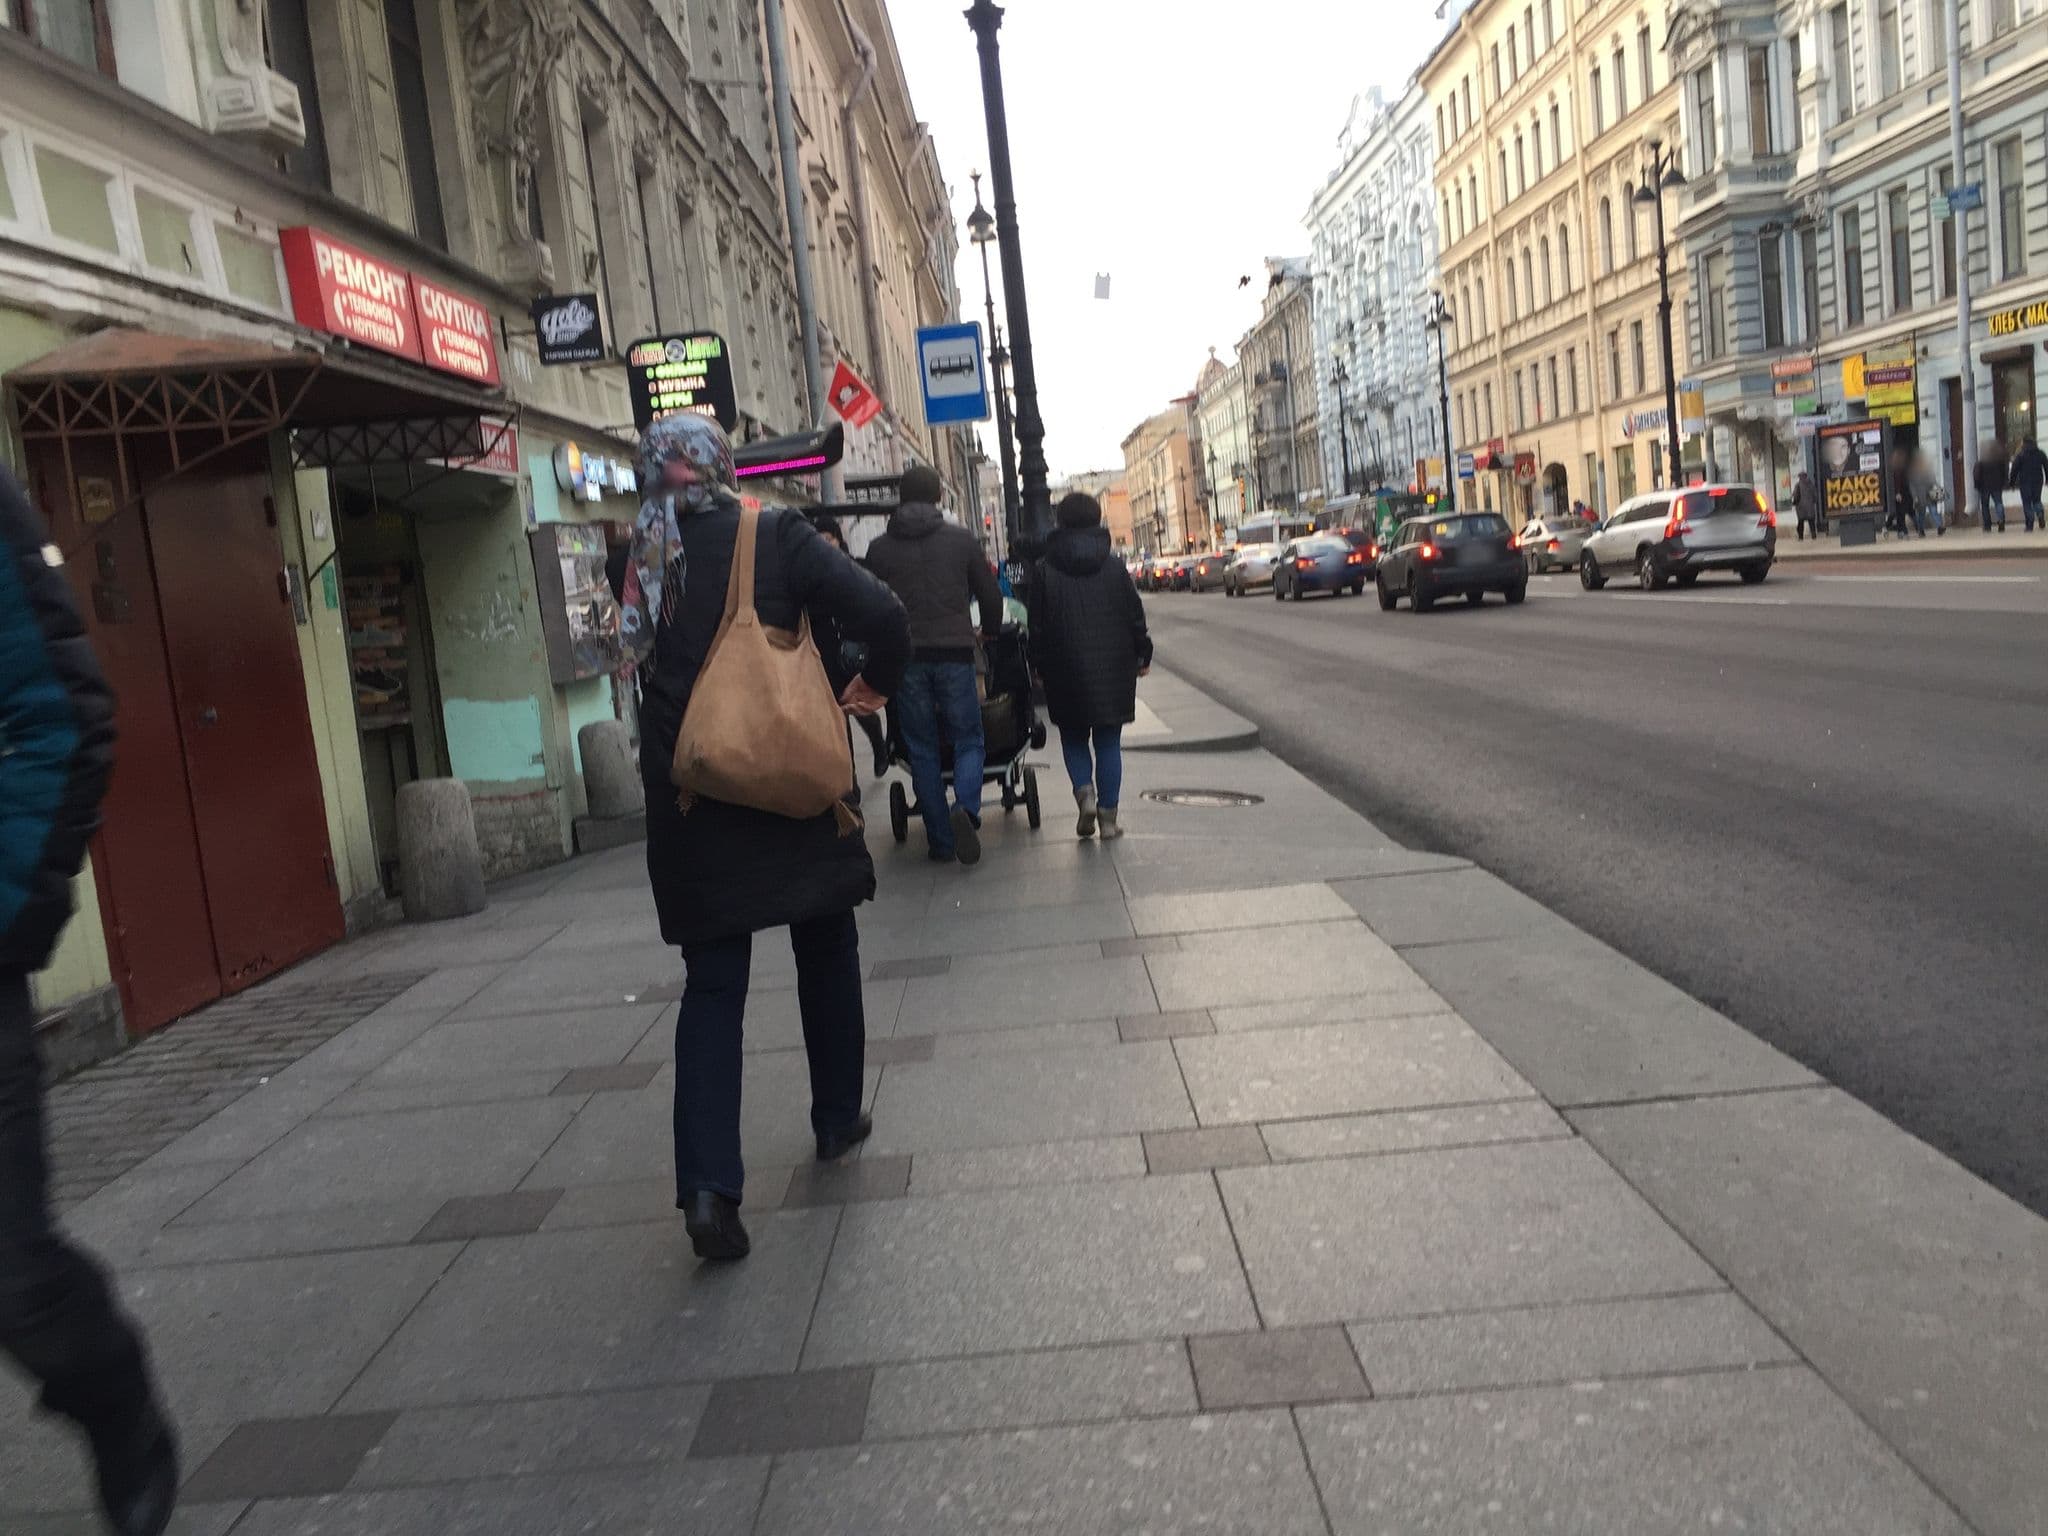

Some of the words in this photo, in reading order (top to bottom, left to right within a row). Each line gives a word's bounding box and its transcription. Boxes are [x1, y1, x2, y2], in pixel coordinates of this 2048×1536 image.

[315, 239, 406, 311] РЕМОНТ
[420, 284, 489, 341] СКУПКА
[1987, 309, 2015, 337] ХЛЕБ
[2017, 307, 2024, 329] С
[654, 360, 708, 379] ФИЛЬМЫ
[657, 375, 706, 393] МУЗЫКА
[660, 391, 693, 408] ИГРЫ
[1826, 472, 1879, 495] МАКС
[1827, 487, 1881, 509] КОРЖ
